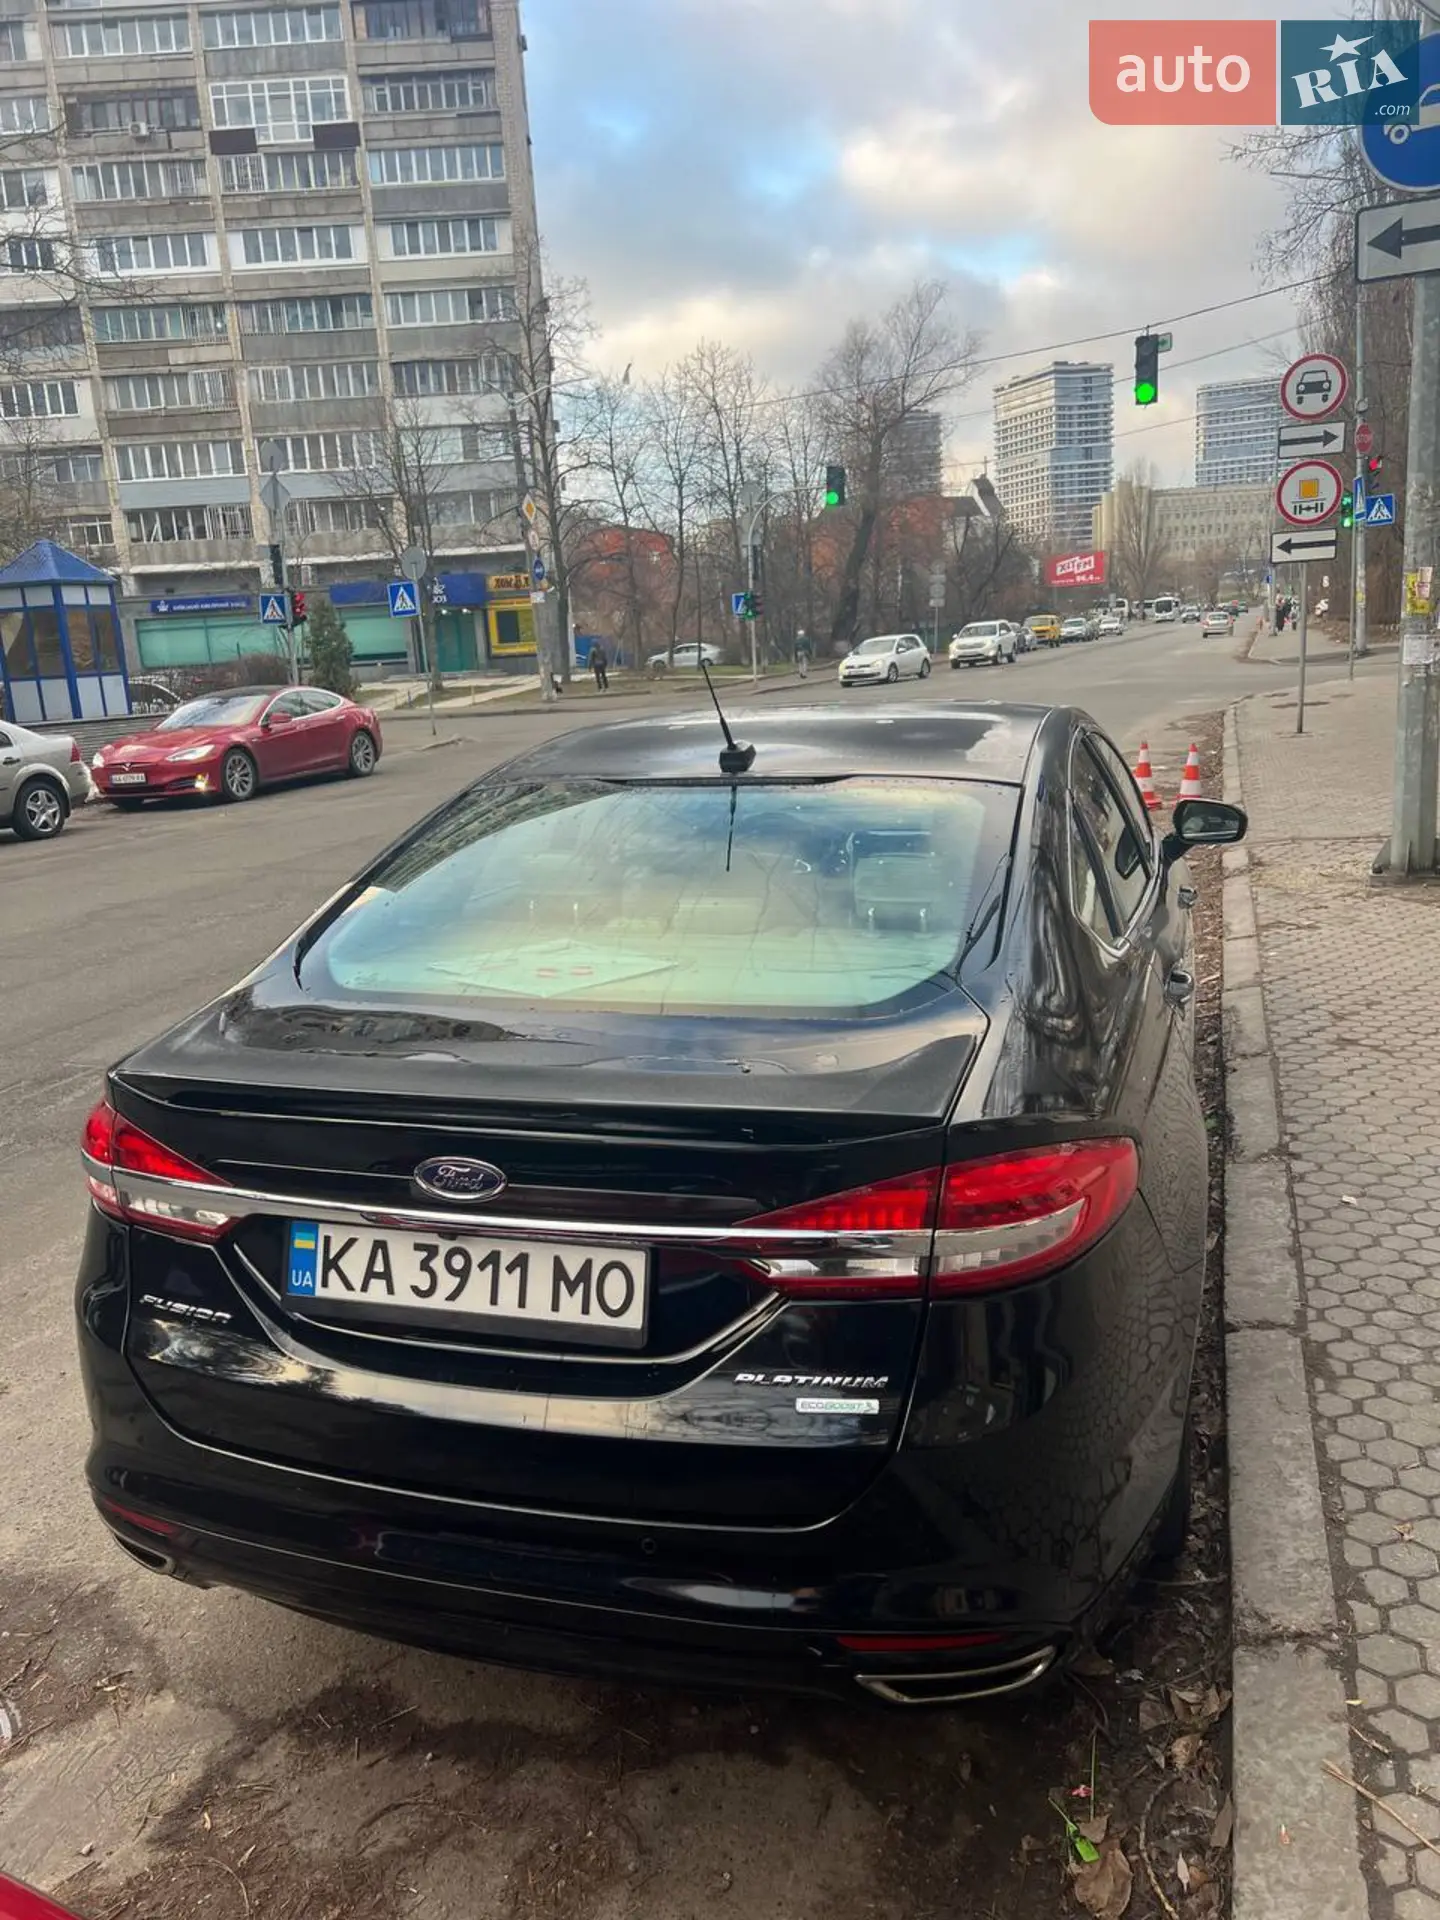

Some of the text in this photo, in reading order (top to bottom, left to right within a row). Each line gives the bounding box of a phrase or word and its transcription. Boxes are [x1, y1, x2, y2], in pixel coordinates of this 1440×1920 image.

[432, 1164, 485, 1191] Ford
[291, 1269, 313, 1289] UA
[320, 1234, 635, 1319] KA 3911 MO
[140, 1294, 232, 1325] FUSION
[734, 1372, 889, 1389] PLATINUM
